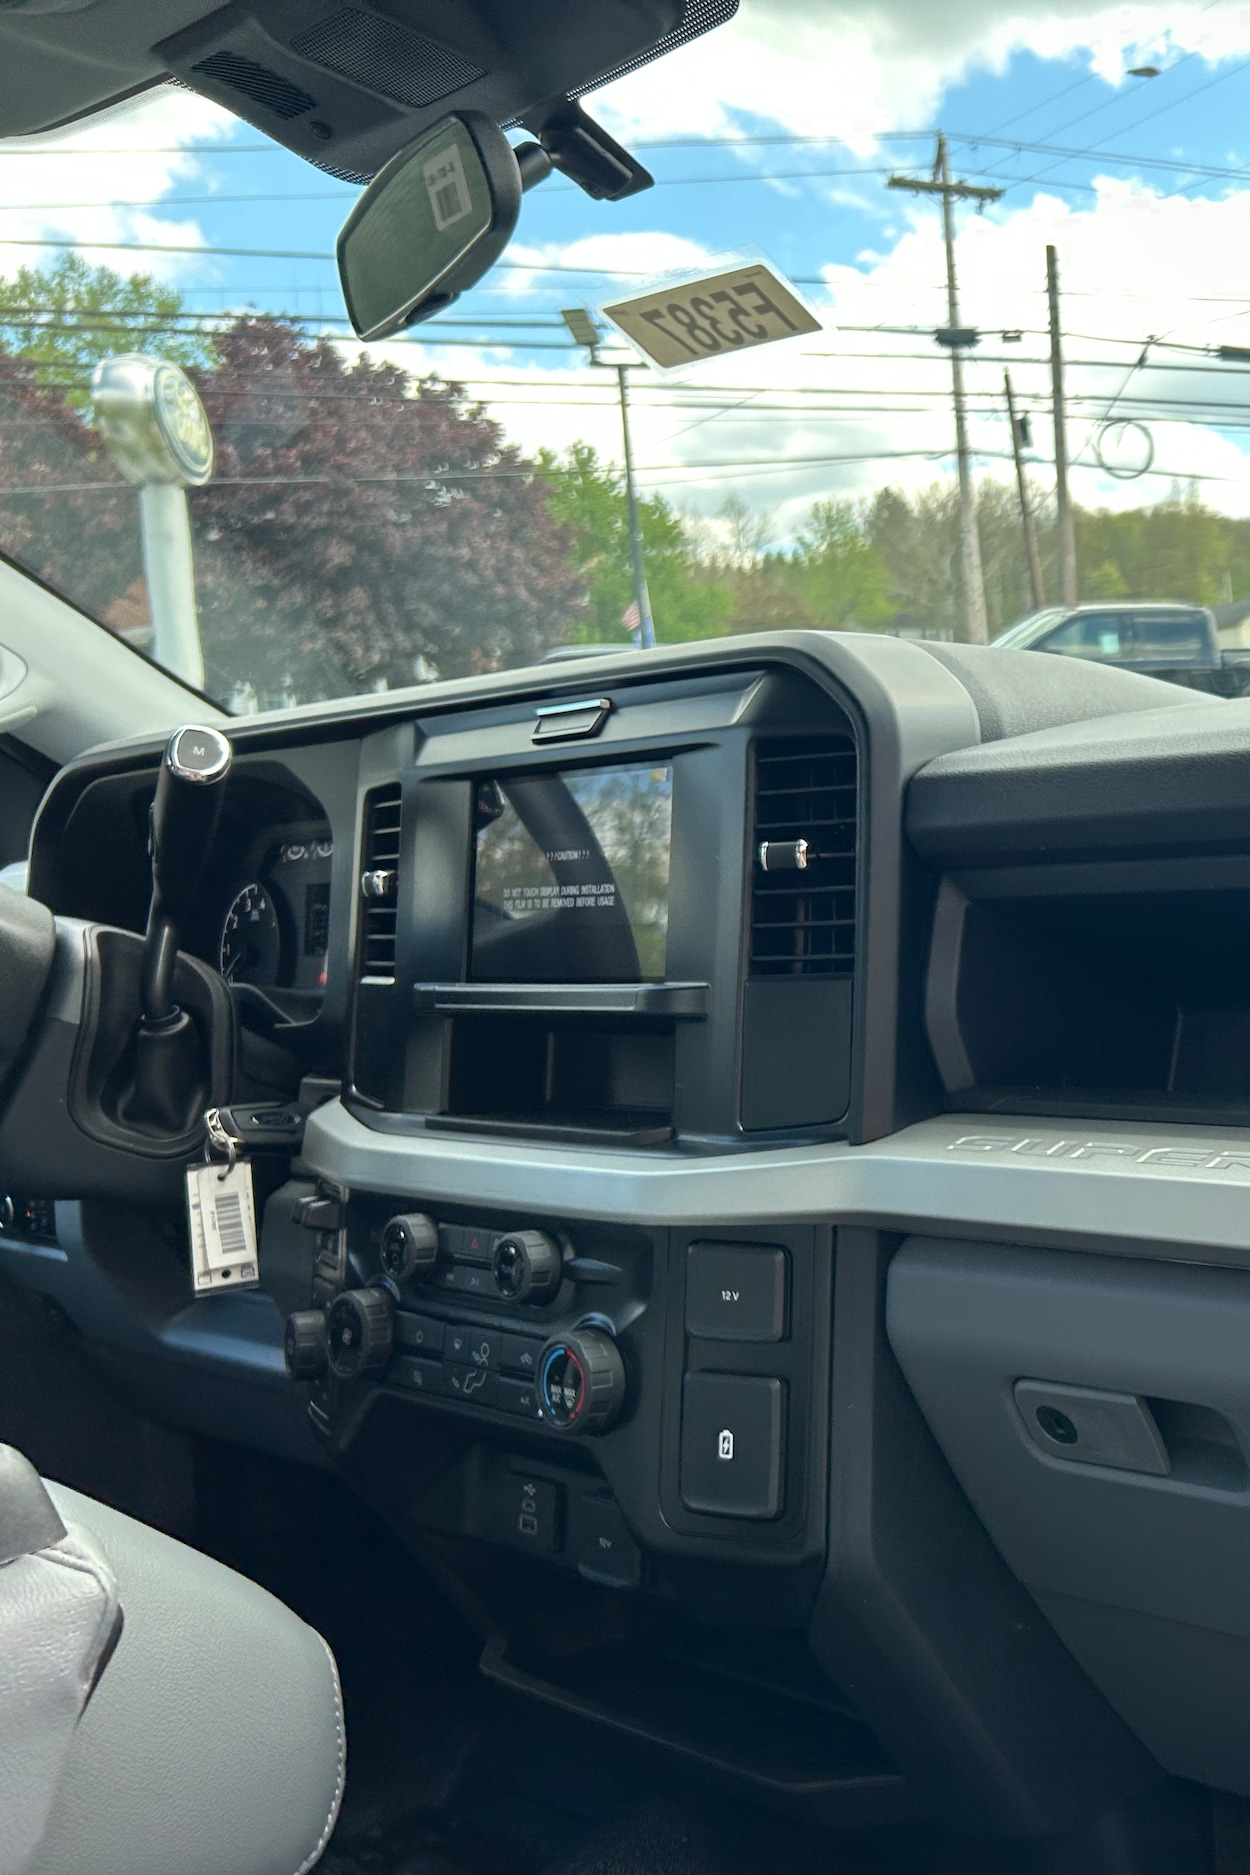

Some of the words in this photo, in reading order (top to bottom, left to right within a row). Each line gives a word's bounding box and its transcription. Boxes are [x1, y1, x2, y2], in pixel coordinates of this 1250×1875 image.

[193, 745, 205, 756] M
[523, 887, 539, 897] TOUCH
[561, 885, 579, 895] DURING
[581, 884, 614, 894] INSTALLATION
[551, 898, 574, 907] REMOVED
[576, 897, 595, 906] BEFORE
[597, 896, 614, 905] USAGE
